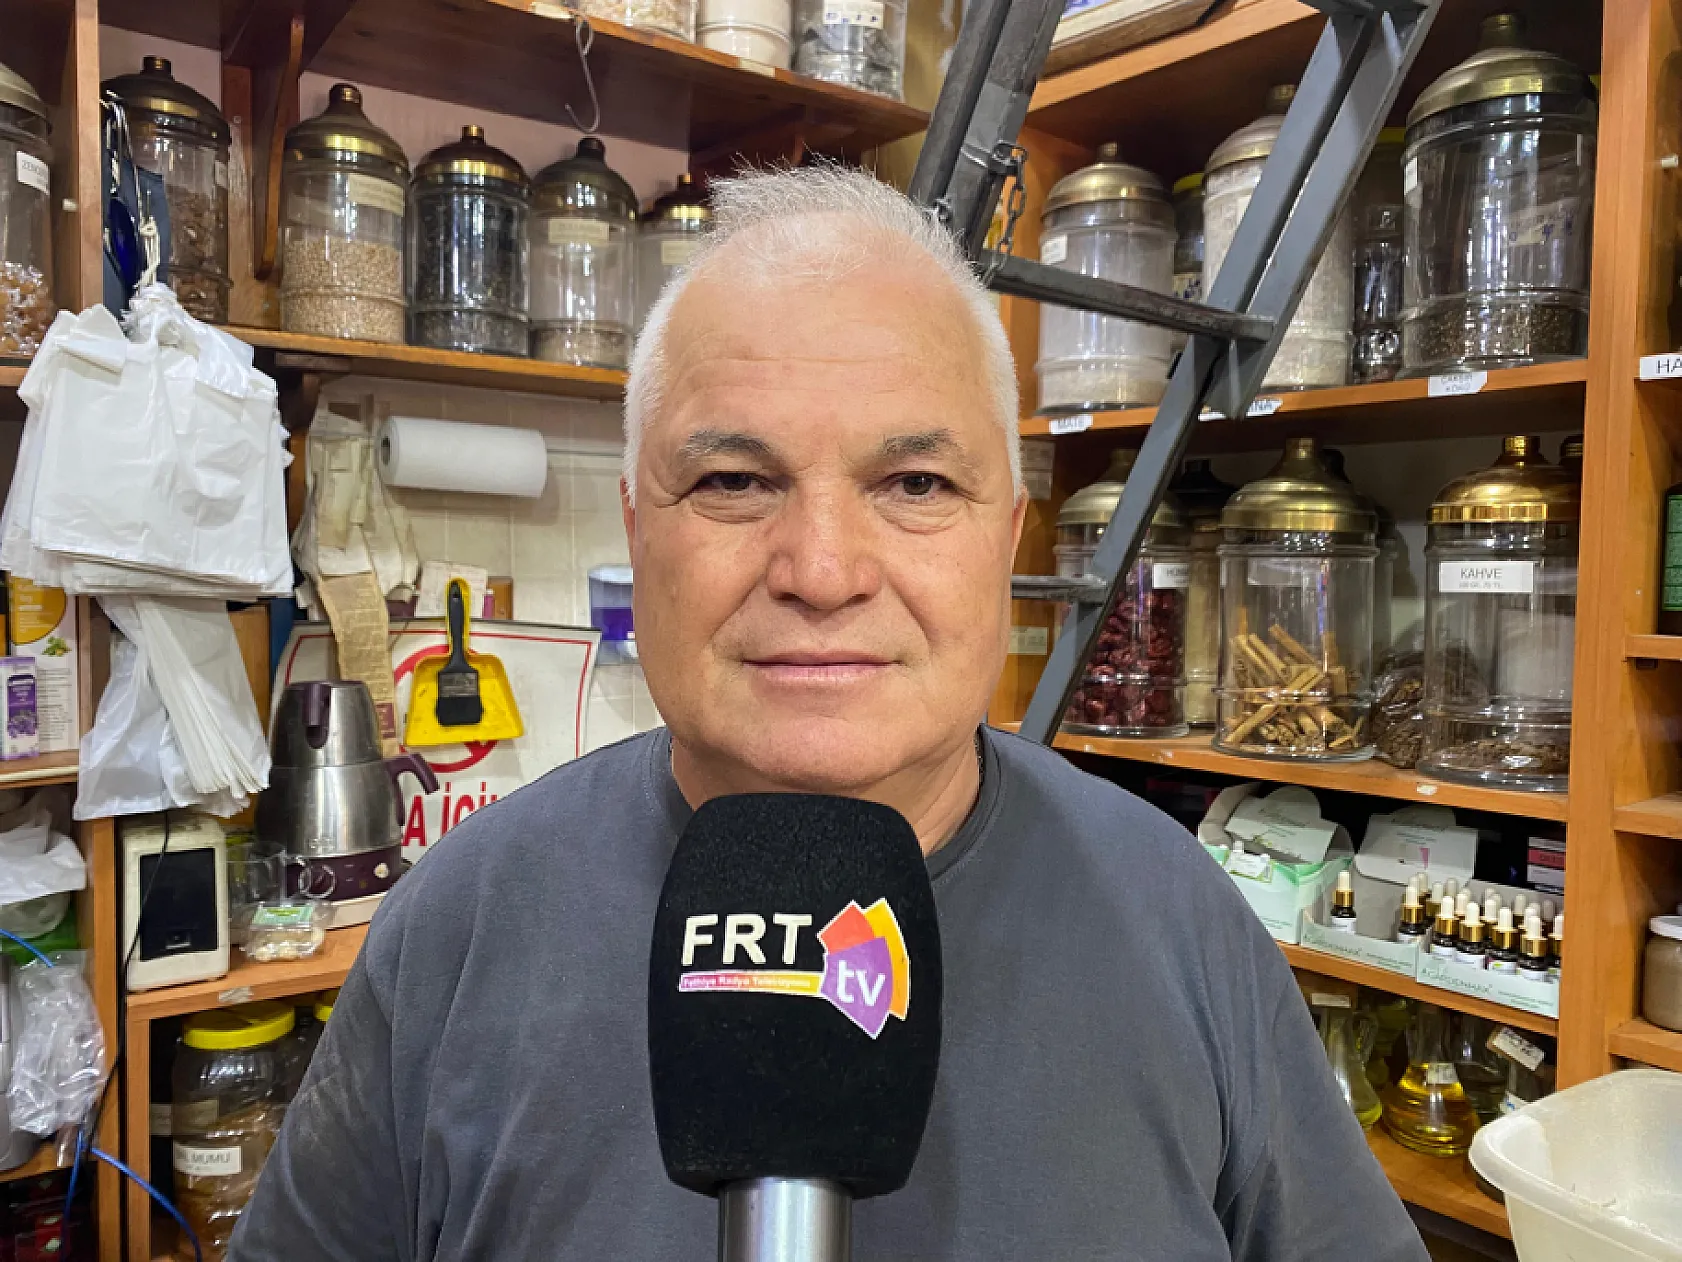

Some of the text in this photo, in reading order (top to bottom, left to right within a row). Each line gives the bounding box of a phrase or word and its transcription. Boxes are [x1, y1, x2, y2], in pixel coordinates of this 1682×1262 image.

[1460, 568, 1502, 579] KAHVE
[680, 913, 812, 967] FRT
[836, 959, 886, 1007] tv
